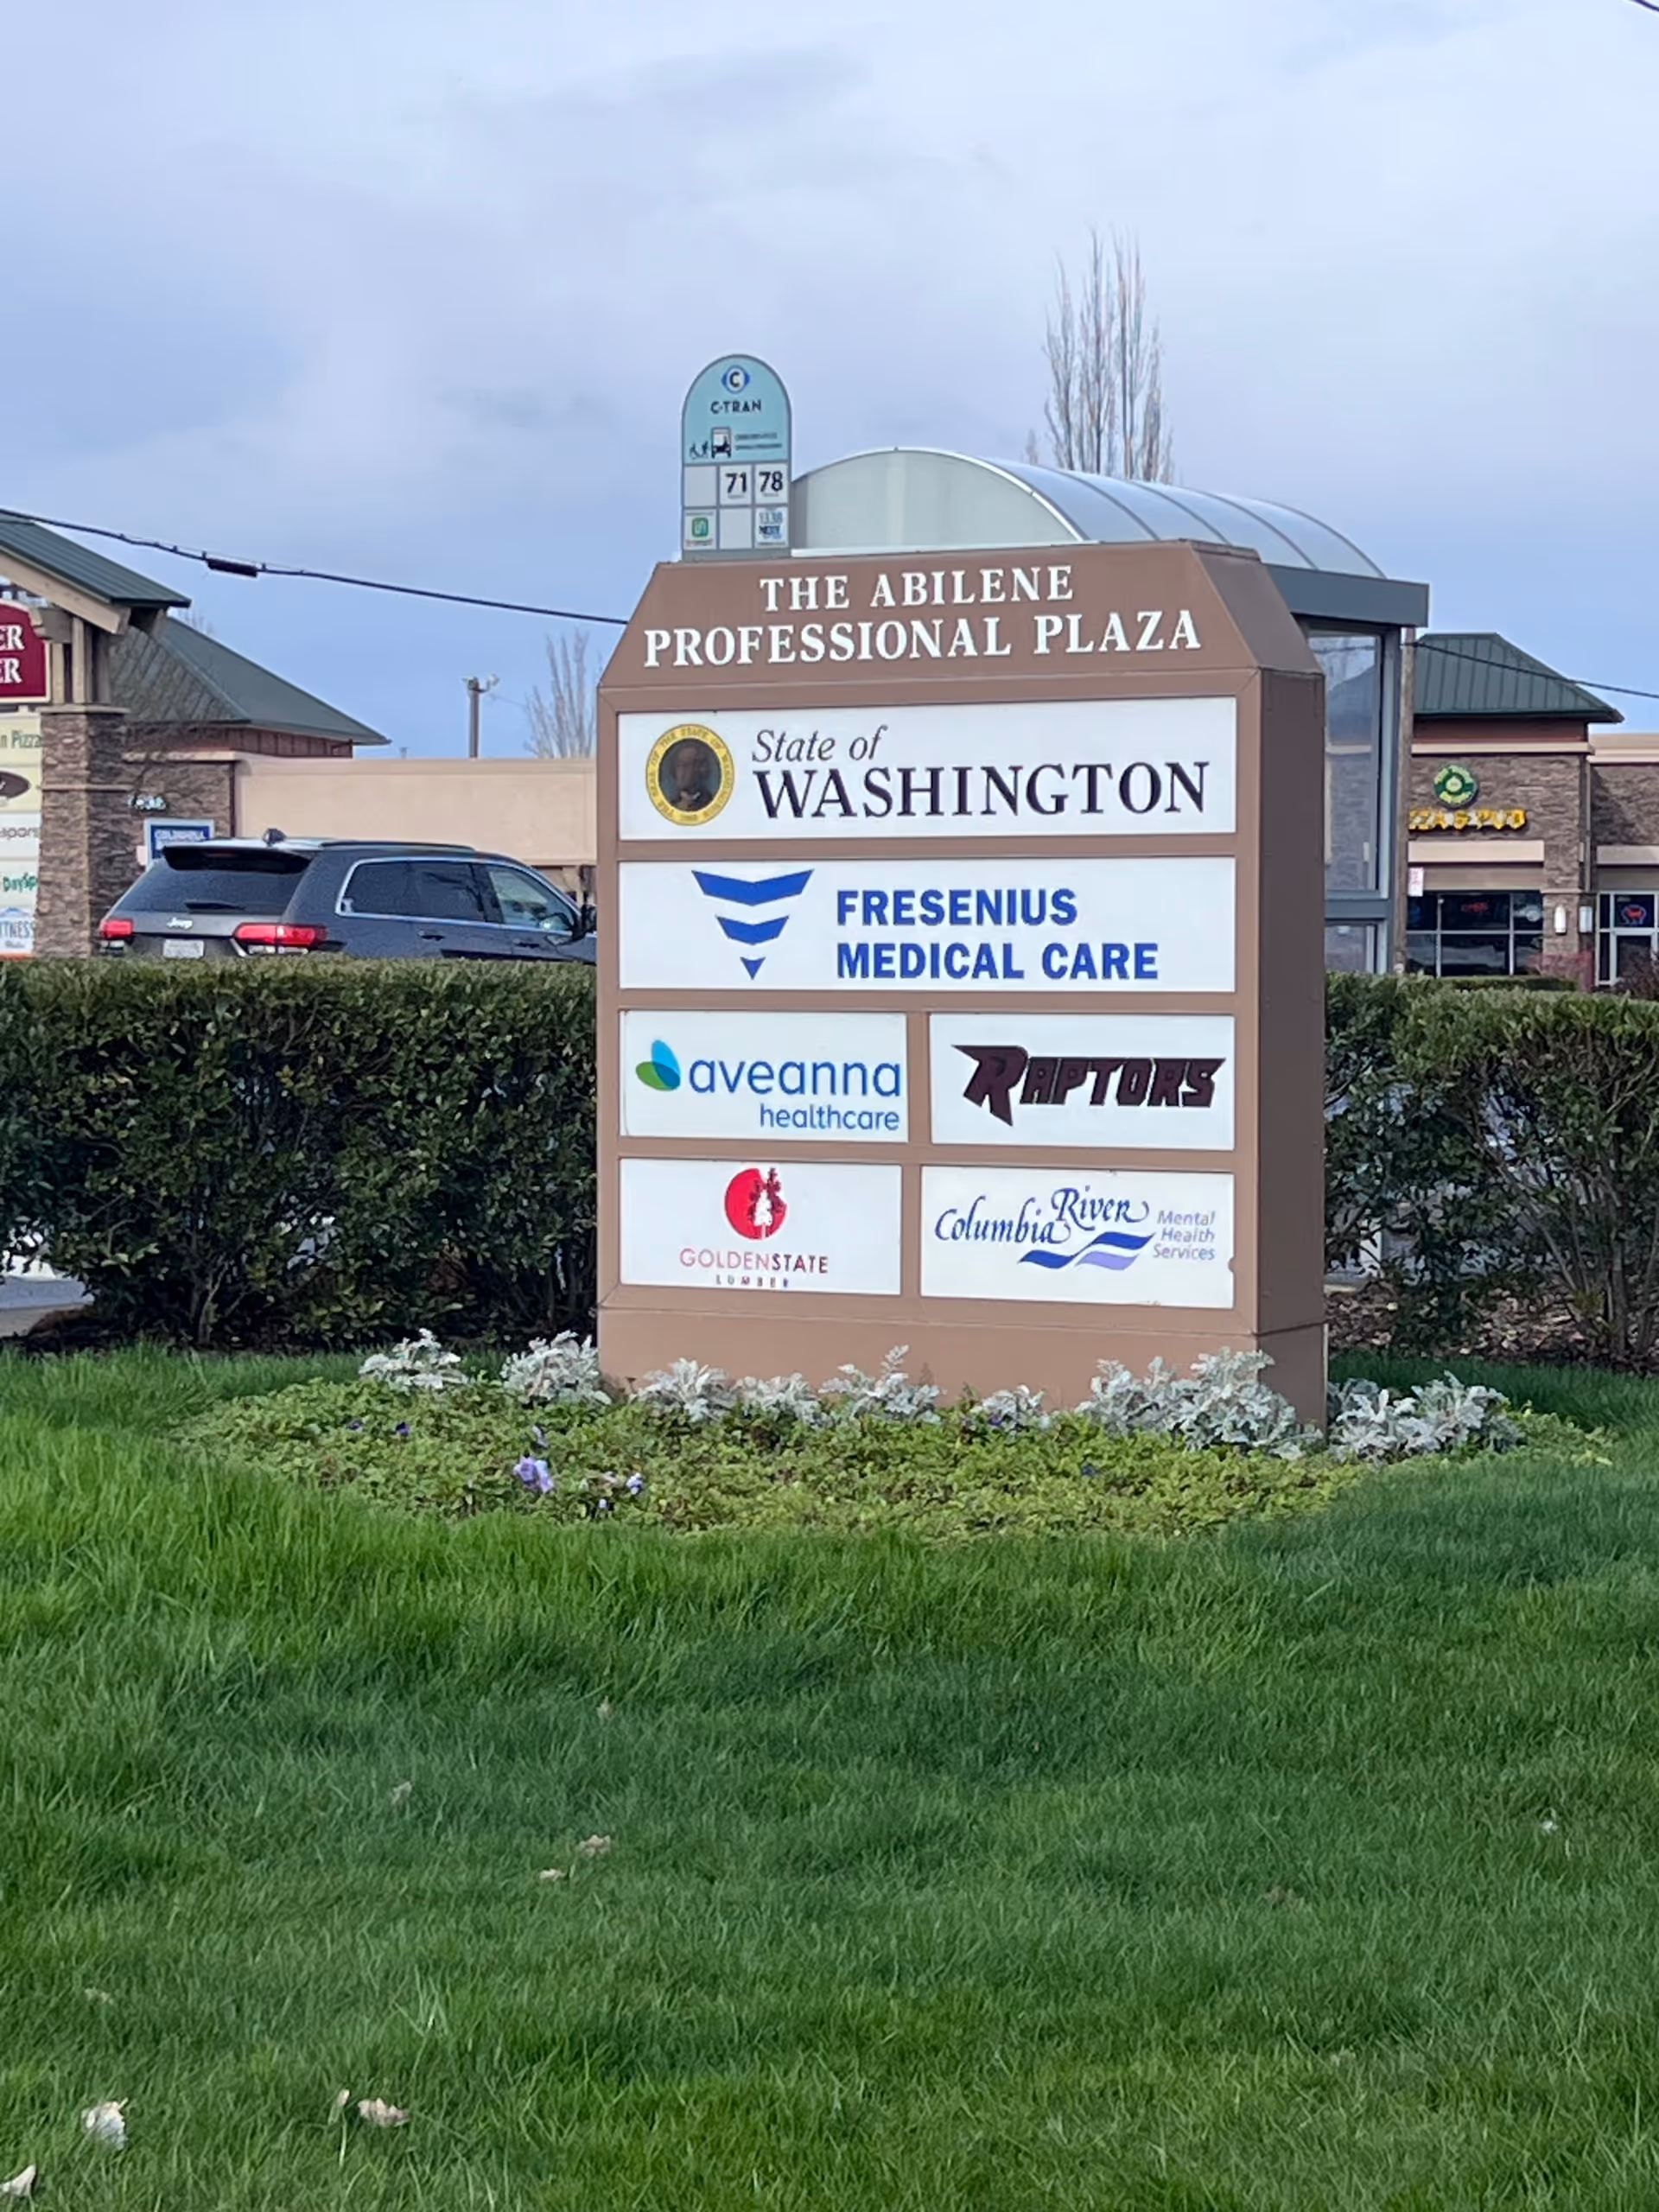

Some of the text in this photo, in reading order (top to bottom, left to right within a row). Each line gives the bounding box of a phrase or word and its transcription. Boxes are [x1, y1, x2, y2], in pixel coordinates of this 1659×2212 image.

[725, 472, 747, 493] 71
[759, 471, 784, 493] 78
[760, 564, 1074, 612] THE ABILENE
[643, 609, 1202, 668] PROFESSIONAL PLAZA
[751, 724, 888, 763] State of
[752, 760, 1211, 819] WASHINGTON
[836, 888, 1078, 926] FRESENIUS
[836, 943, 1159, 980] MEDICAL CARE
[689, 1059, 901, 1097] aveanna
[951, 1044, 1227, 1127] RAPTORS
[760, 1103, 900, 1131] healthcare
[934, 1185, 1150, 1244] Columbia River
[1156, 1210, 1216, 1226] Mental
[1153, 1243, 1217, 1262] Services
[1160, 1227, 1215, 1243] Health
[679, 1247, 830, 1274] GOLDENSTATE
